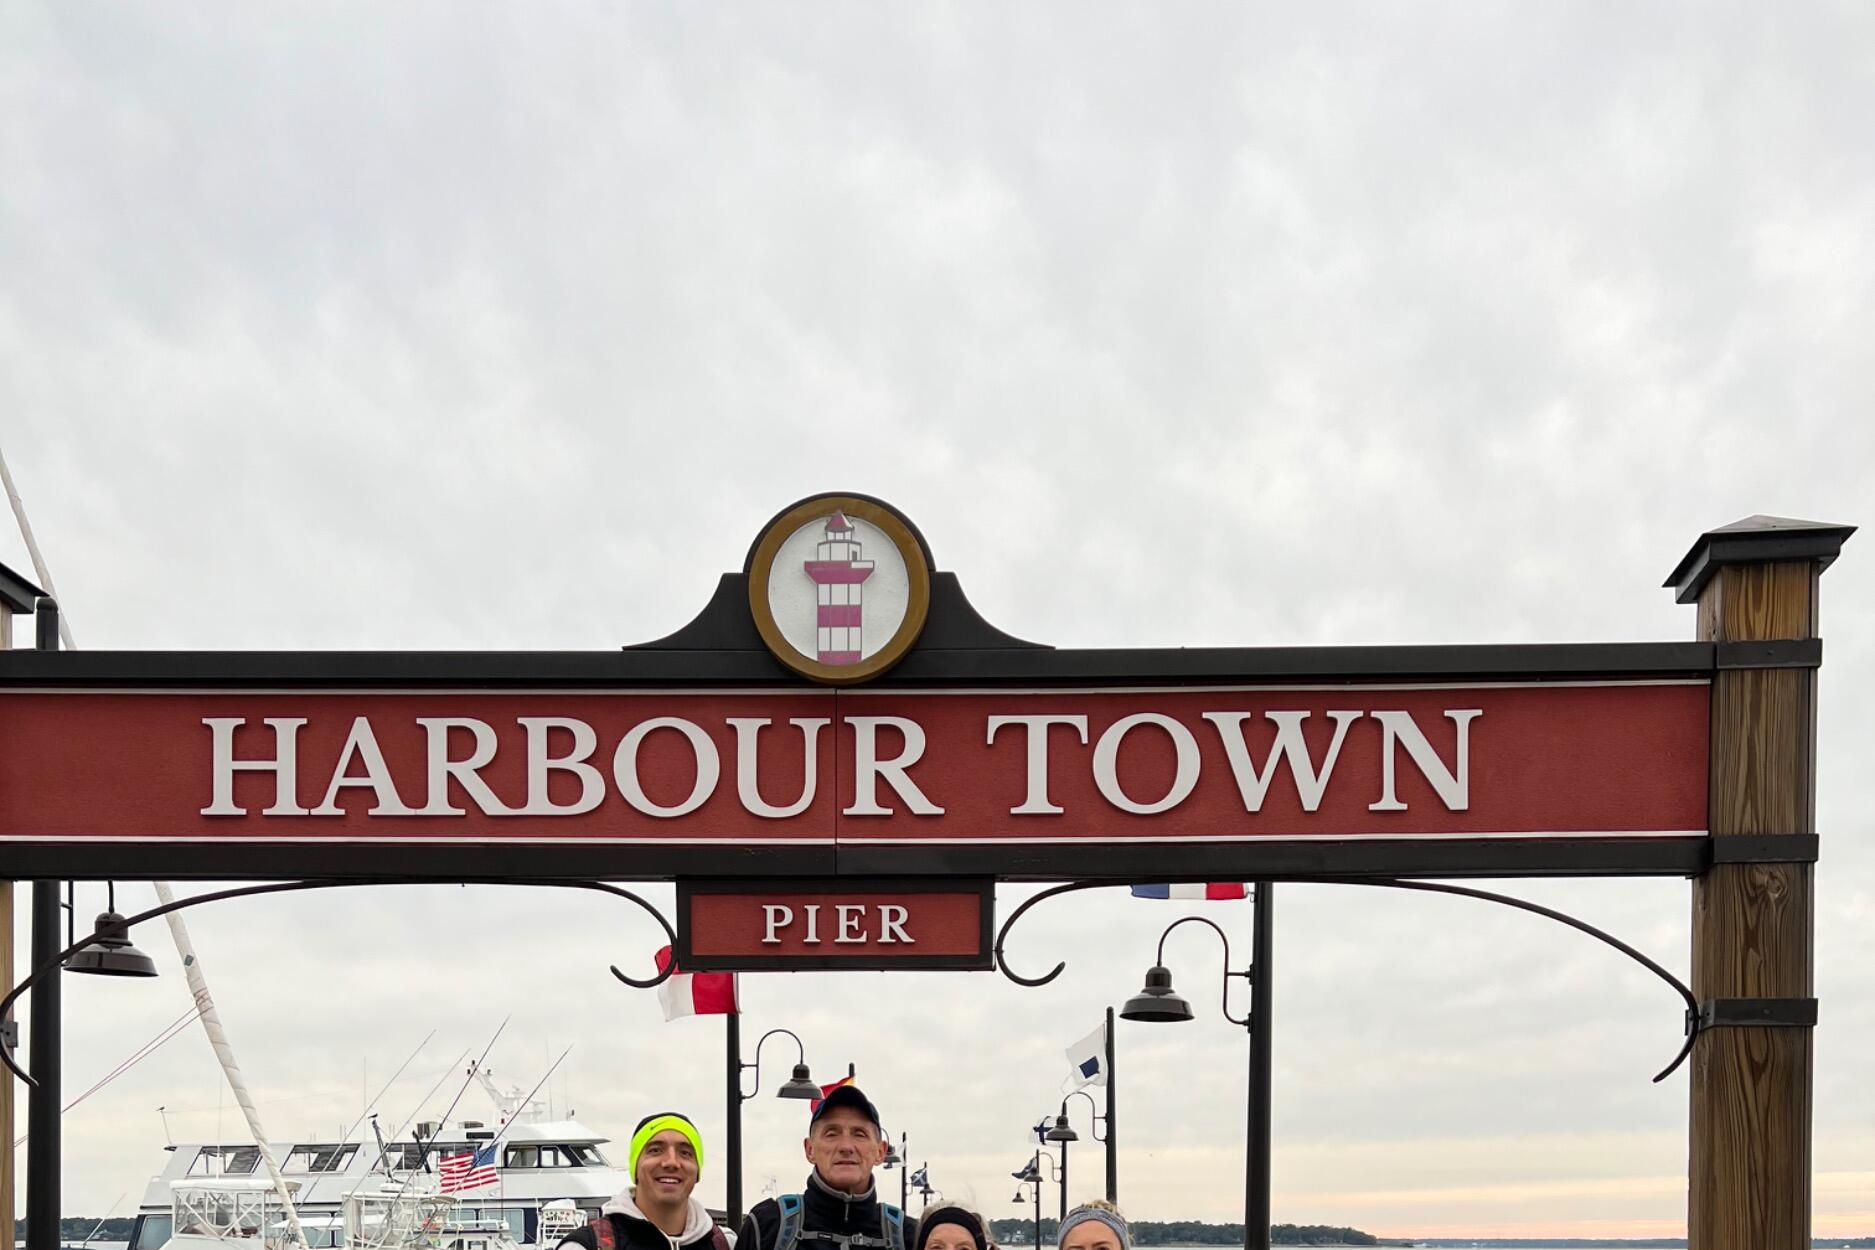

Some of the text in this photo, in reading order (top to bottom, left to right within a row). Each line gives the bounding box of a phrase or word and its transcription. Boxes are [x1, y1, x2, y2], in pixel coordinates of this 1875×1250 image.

[200, 708, 1484, 819] HARBOUR TOWN
[761, 904, 916, 943] PIER
